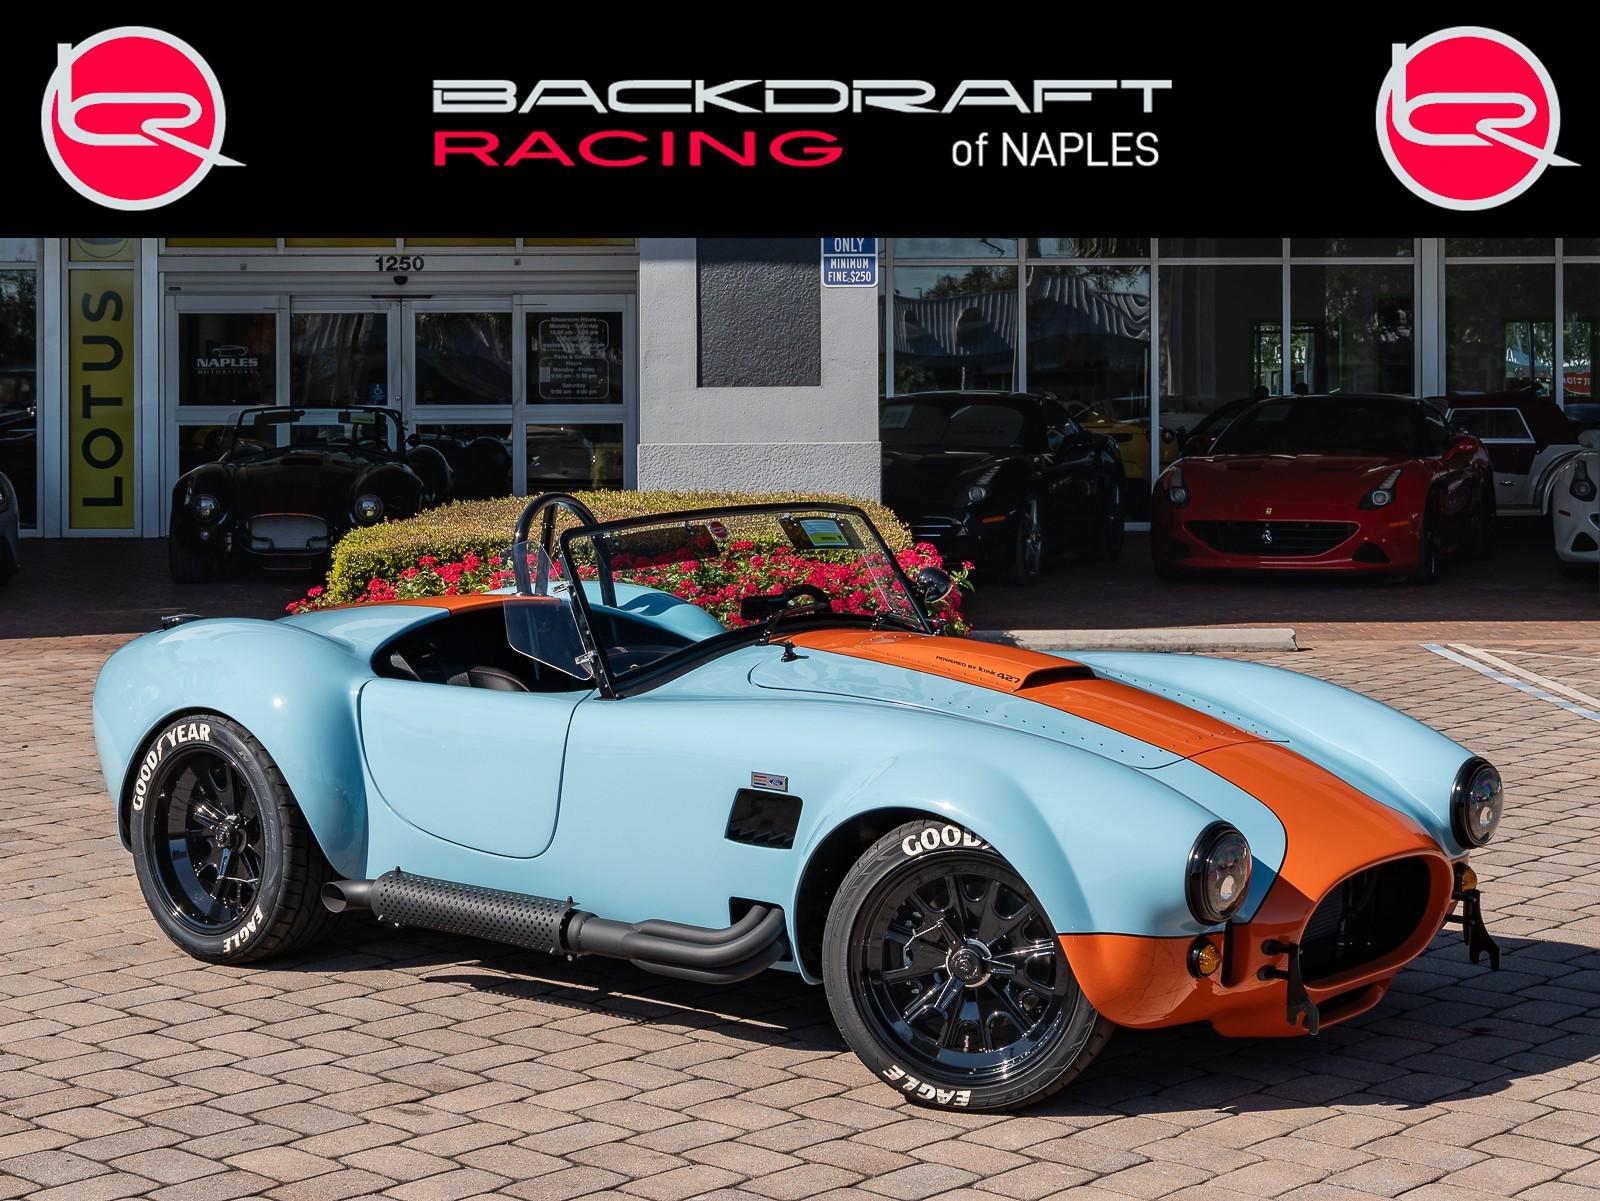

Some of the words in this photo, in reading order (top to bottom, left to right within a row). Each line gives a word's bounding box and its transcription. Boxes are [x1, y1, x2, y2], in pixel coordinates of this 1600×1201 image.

[834, 237, 865, 252] ONLY
[375, 255, 425, 272] 1250
[830, 258, 869, 269] MINIMUM
[828, 271, 847, 282] FINE
[850, 270, 872, 283] $250
[196, 357, 259, 368] NAPLES
[81, 290, 124, 507] LOTUS
[935, 655, 967, 667] POWERED
[997, 672, 1021, 684] 427
[133, 723, 211, 811] GOODYEAR
[223, 904, 266, 953] EAGLE
[883, 1064, 972, 1107] EAGLE
